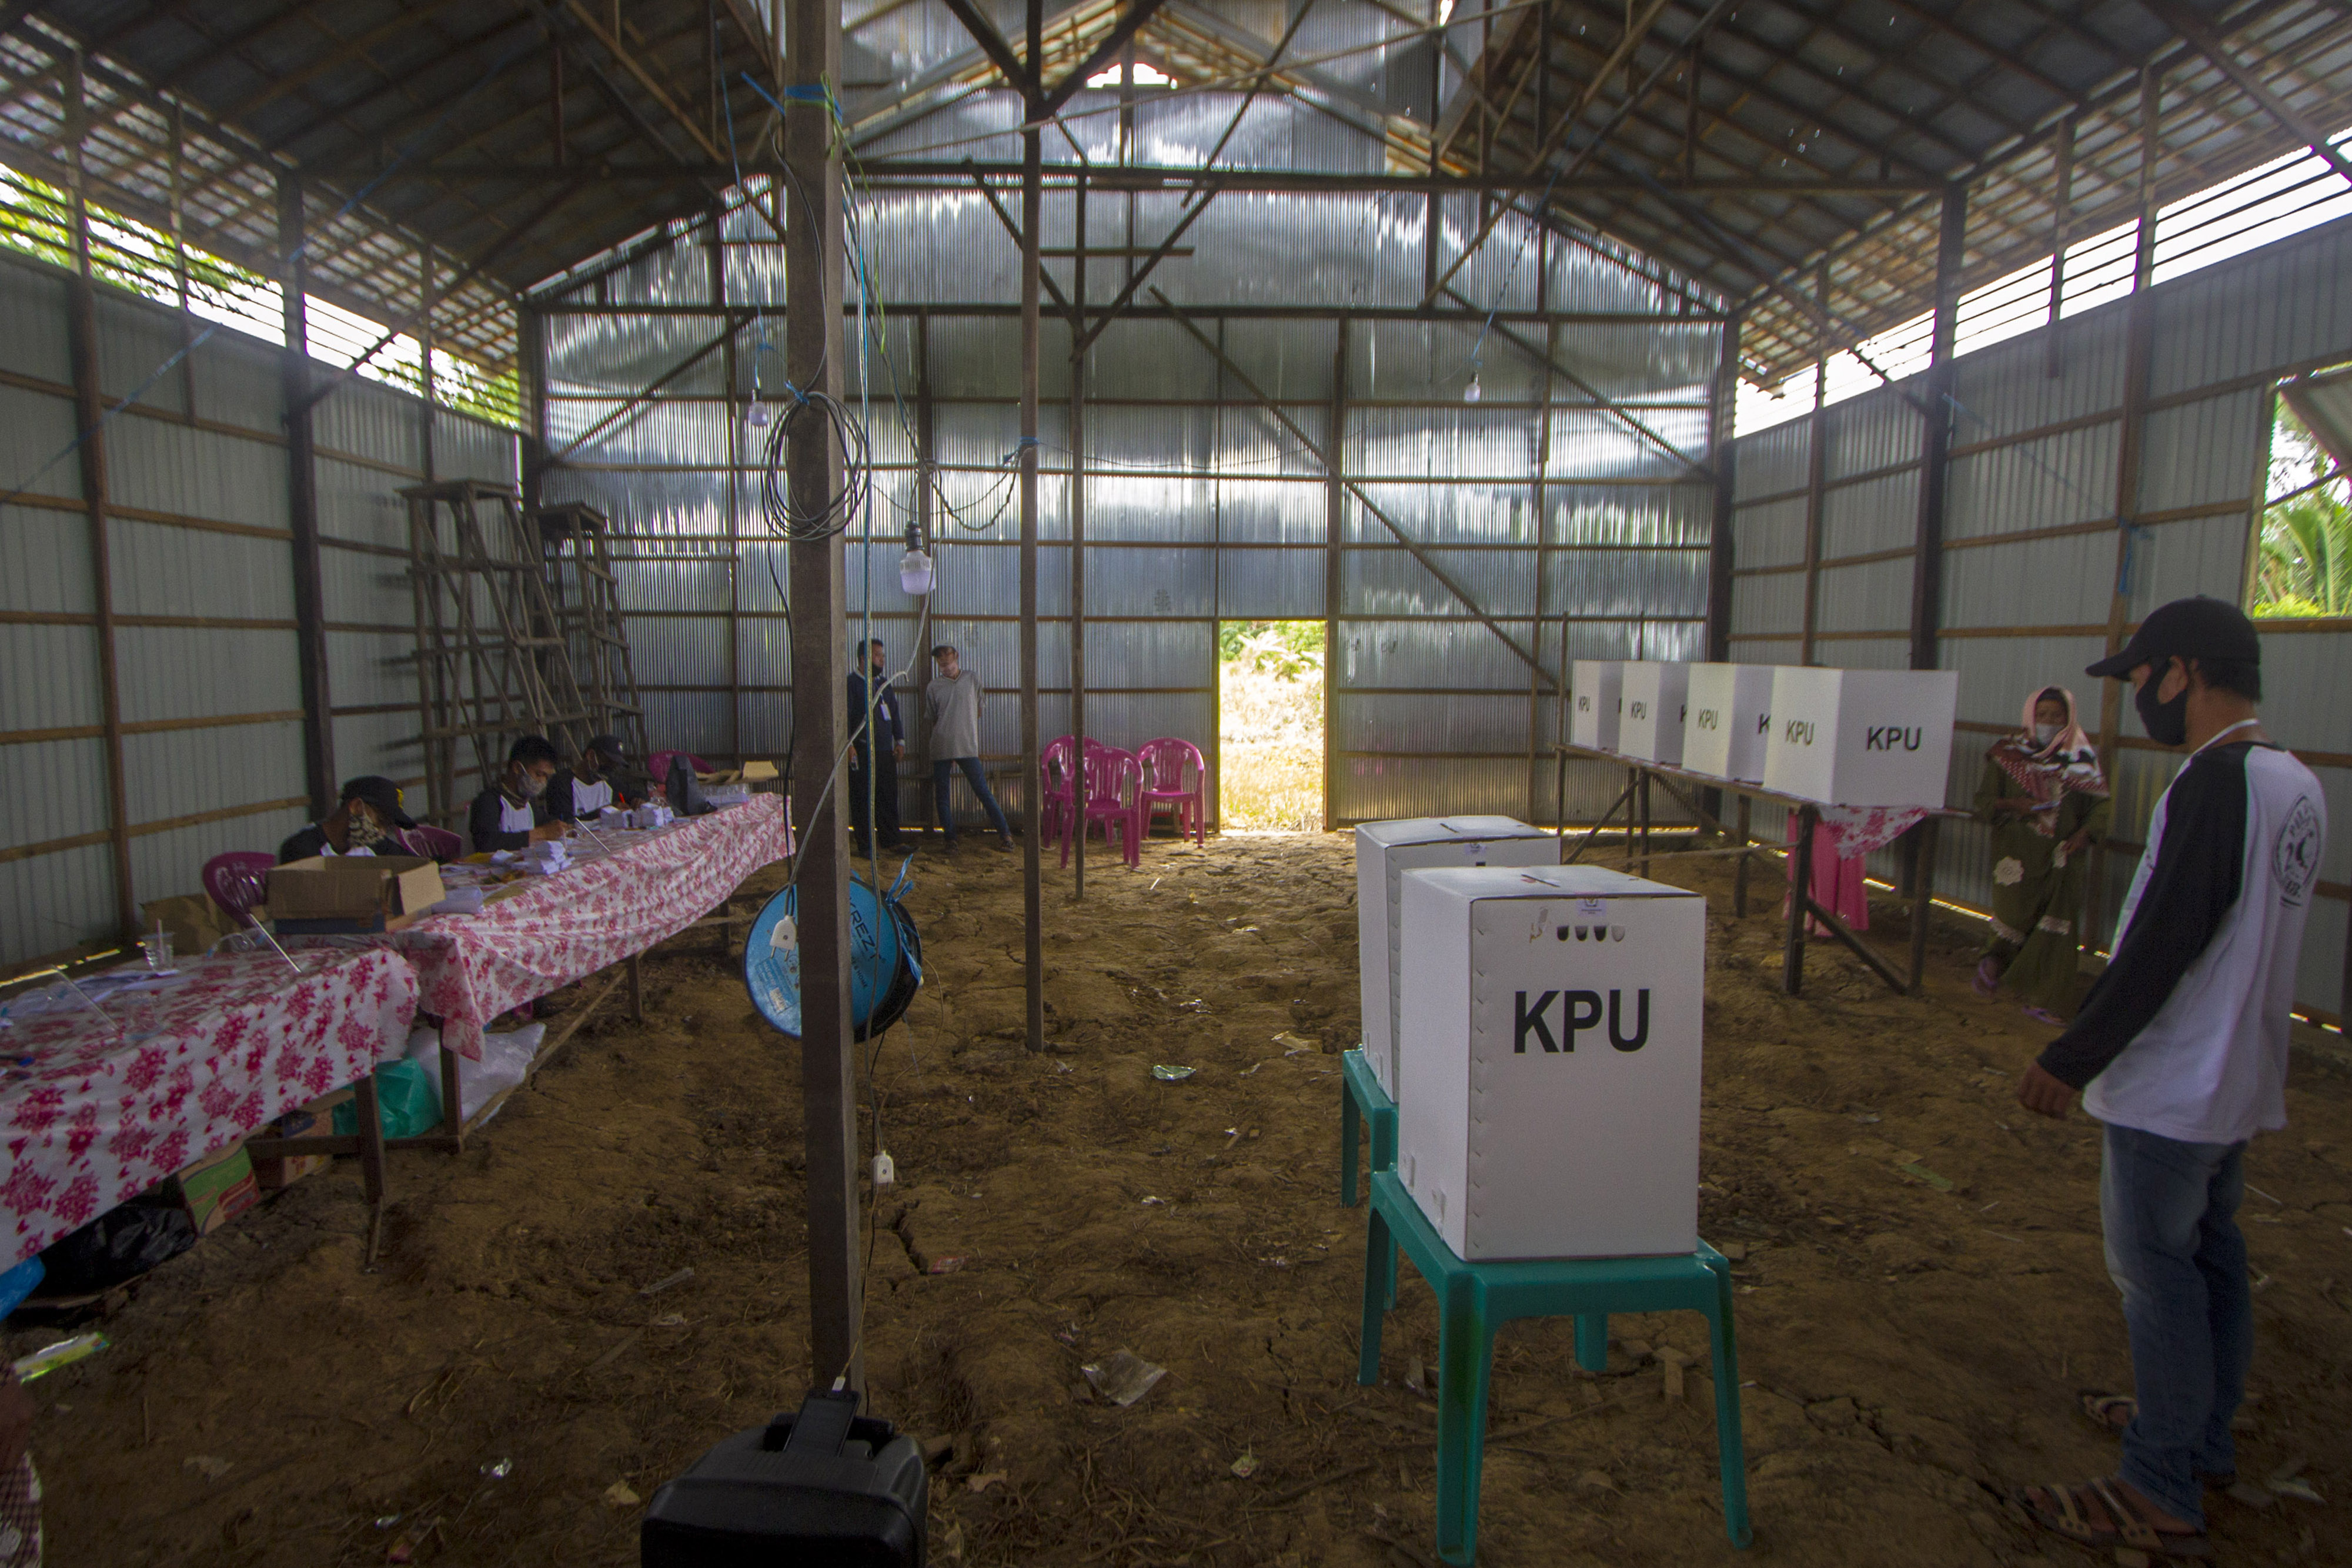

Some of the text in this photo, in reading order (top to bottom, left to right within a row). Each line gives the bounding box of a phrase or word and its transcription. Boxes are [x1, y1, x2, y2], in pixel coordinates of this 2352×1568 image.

[1579, 696, 1591, 712] KPU
[1631, 701, 1647, 720] KPU
[1698, 708, 1718, 730] KPU
[1785, 720, 1815, 745] KPU
[1867, 726, 1922, 751] KPU
[1514, 988, 1651, 1054] KPU
